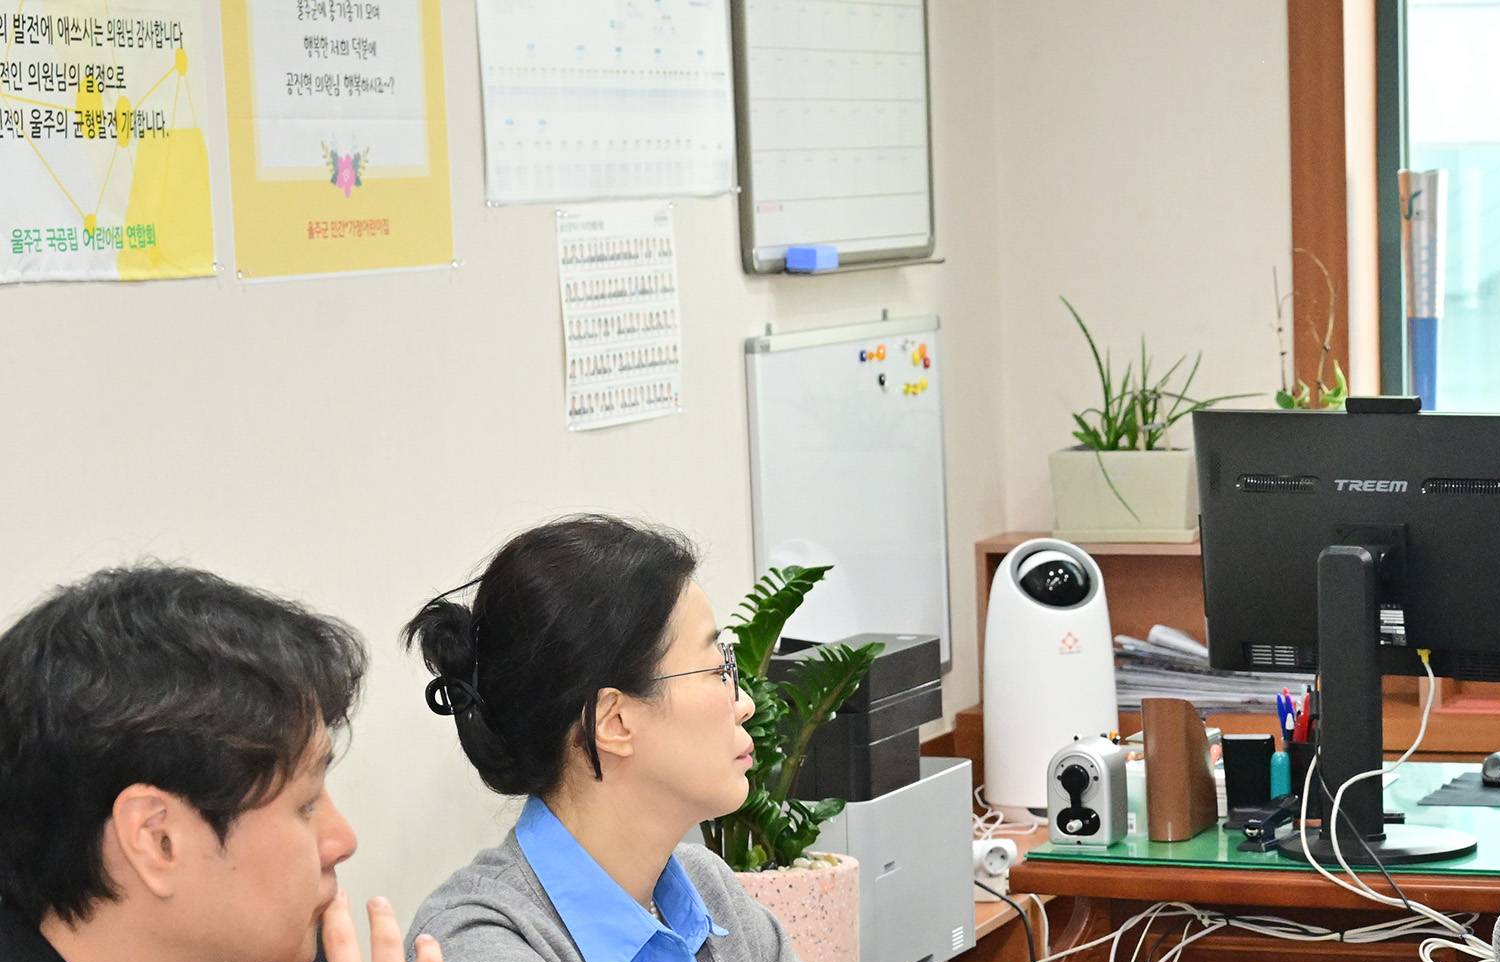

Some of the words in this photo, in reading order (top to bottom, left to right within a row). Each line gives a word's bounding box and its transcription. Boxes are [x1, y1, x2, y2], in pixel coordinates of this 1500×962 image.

[13, 14, 53, 45] 발전에
[57, 16, 103, 47] 애쓰시는
[107, 19, 134, 48] 의원님
[136, 20, 183, 49] 감사합니다
[28, 62, 81, 92] 의원님의
[85, 64, 126, 93] 열정으로
[315, 74, 340, 97] 의원님
[0, 109, 24, 139] 적인
[30, 109, 68, 139] 울주의
[73, 110, 118, 139] 균형발전
[121, 110, 169, 139] 기대합니다.
[11, 228, 42, 254] 울주군
[46, 227, 78, 252] 국공립
[82, 225, 124, 250] 어린이집
[126, 223, 156, 248] 연합회
[1334, 479, 1408, 493] TREEM
